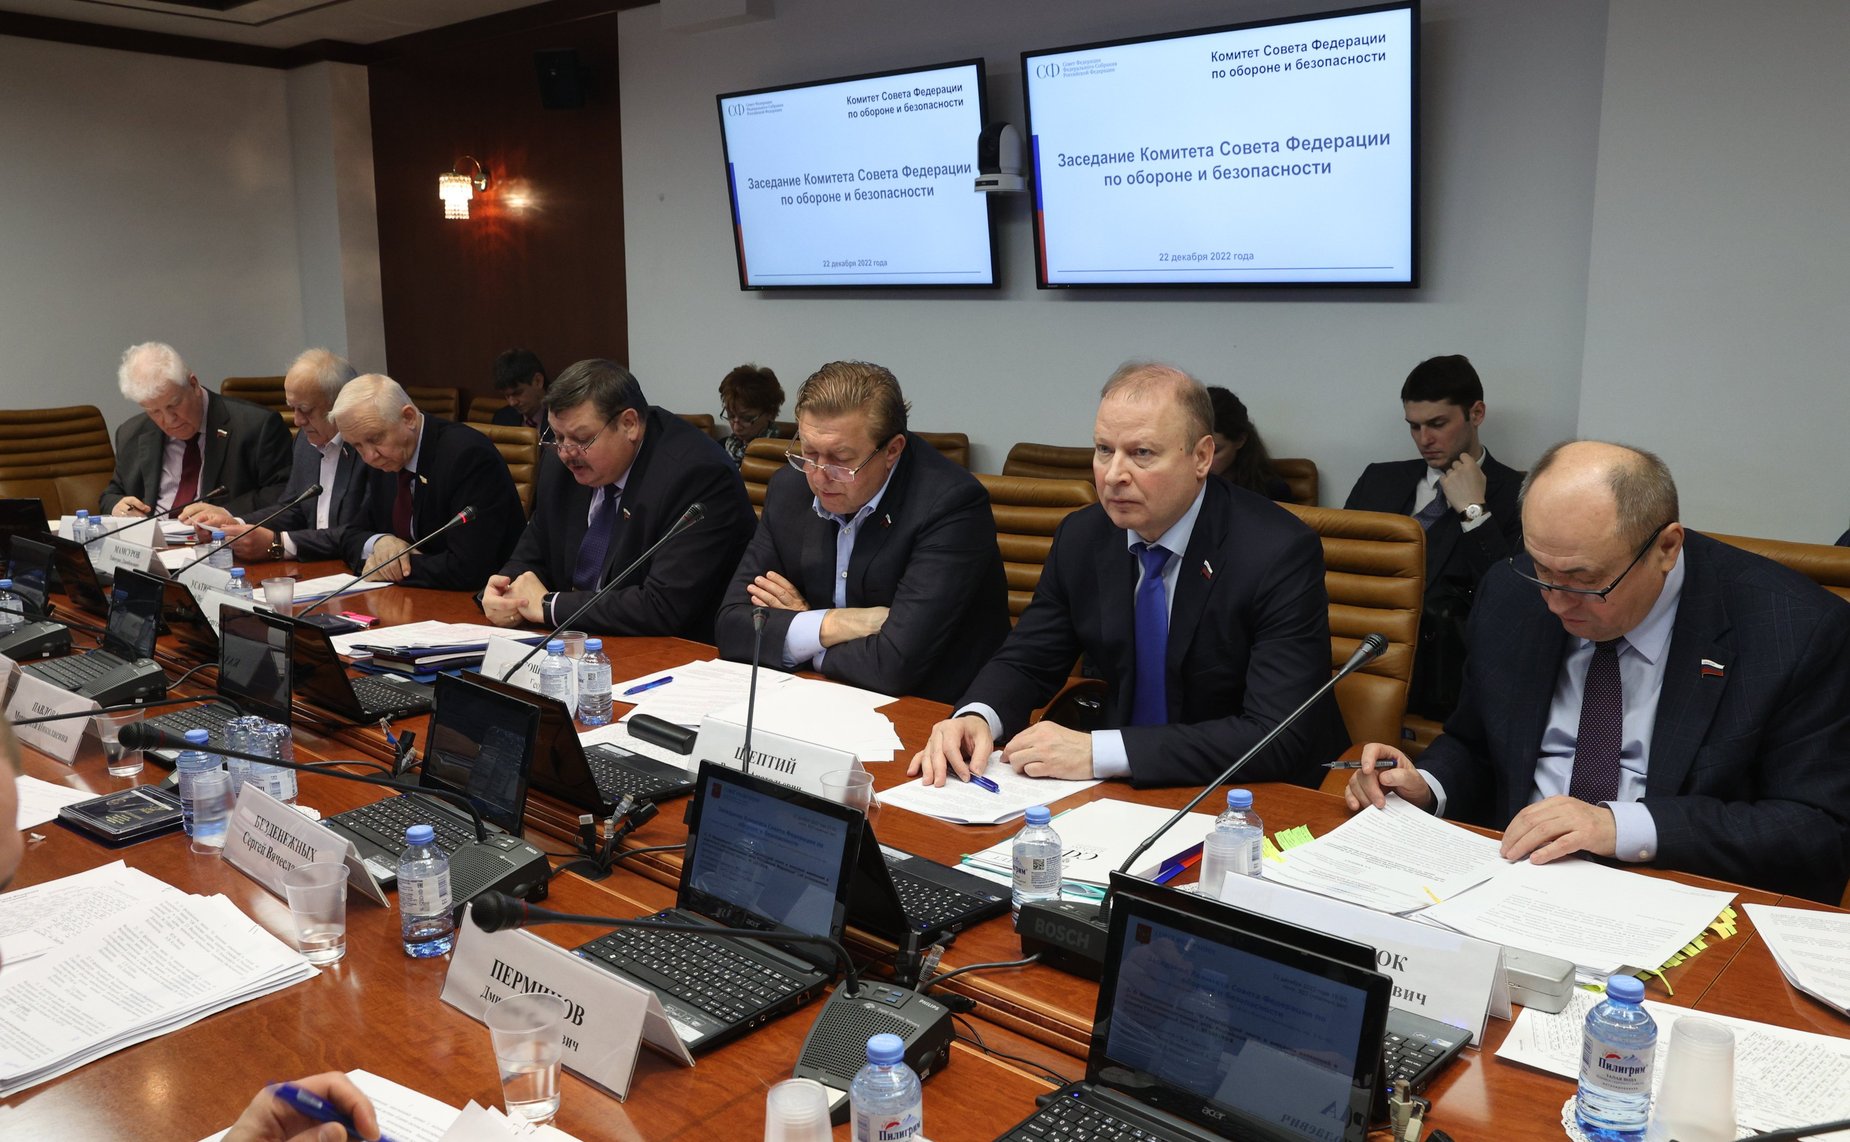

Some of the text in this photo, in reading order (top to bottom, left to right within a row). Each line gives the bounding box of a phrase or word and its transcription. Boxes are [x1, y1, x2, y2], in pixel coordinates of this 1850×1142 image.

[1210, 32, 1387, 63] Комитет Совета Федерации
[1036, 62, 1060, 79] СФ
[1211, 50, 1387, 80] по обороне и безопасности
[846, 84, 964, 106] Комитет Совета Федерации
[847, 97, 964, 119] по обороне и безопасности
[1057, 131, 1391, 168] Заседание Комитета Совета Федерации
[747, 161, 972, 190] Заседание Комитета Совета Федерации
[1104, 158, 1332, 187] по обороне и безопасности
[780, 185, 935, 206] по обороне и безопасности
[822, 258, 888, 268] 22 декабря 2022 года
[1159, 251, 1255, 263] 22 декабря 2022 года
[242, 831, 268, 856] Сергей
[254, 815, 318, 863] БЕЗДЕНЕЖНЫХ
[1034, 917, 1090, 949] BOSCH
[1376, 950, 1408, 973] ОК
[919, 999, 940, 1011] PHILIPS
[1392, 985, 1427, 1007] вич
[1598, 1057, 1646, 1077] Пилигрим
[1201, 1105, 1226, 1120] acer
